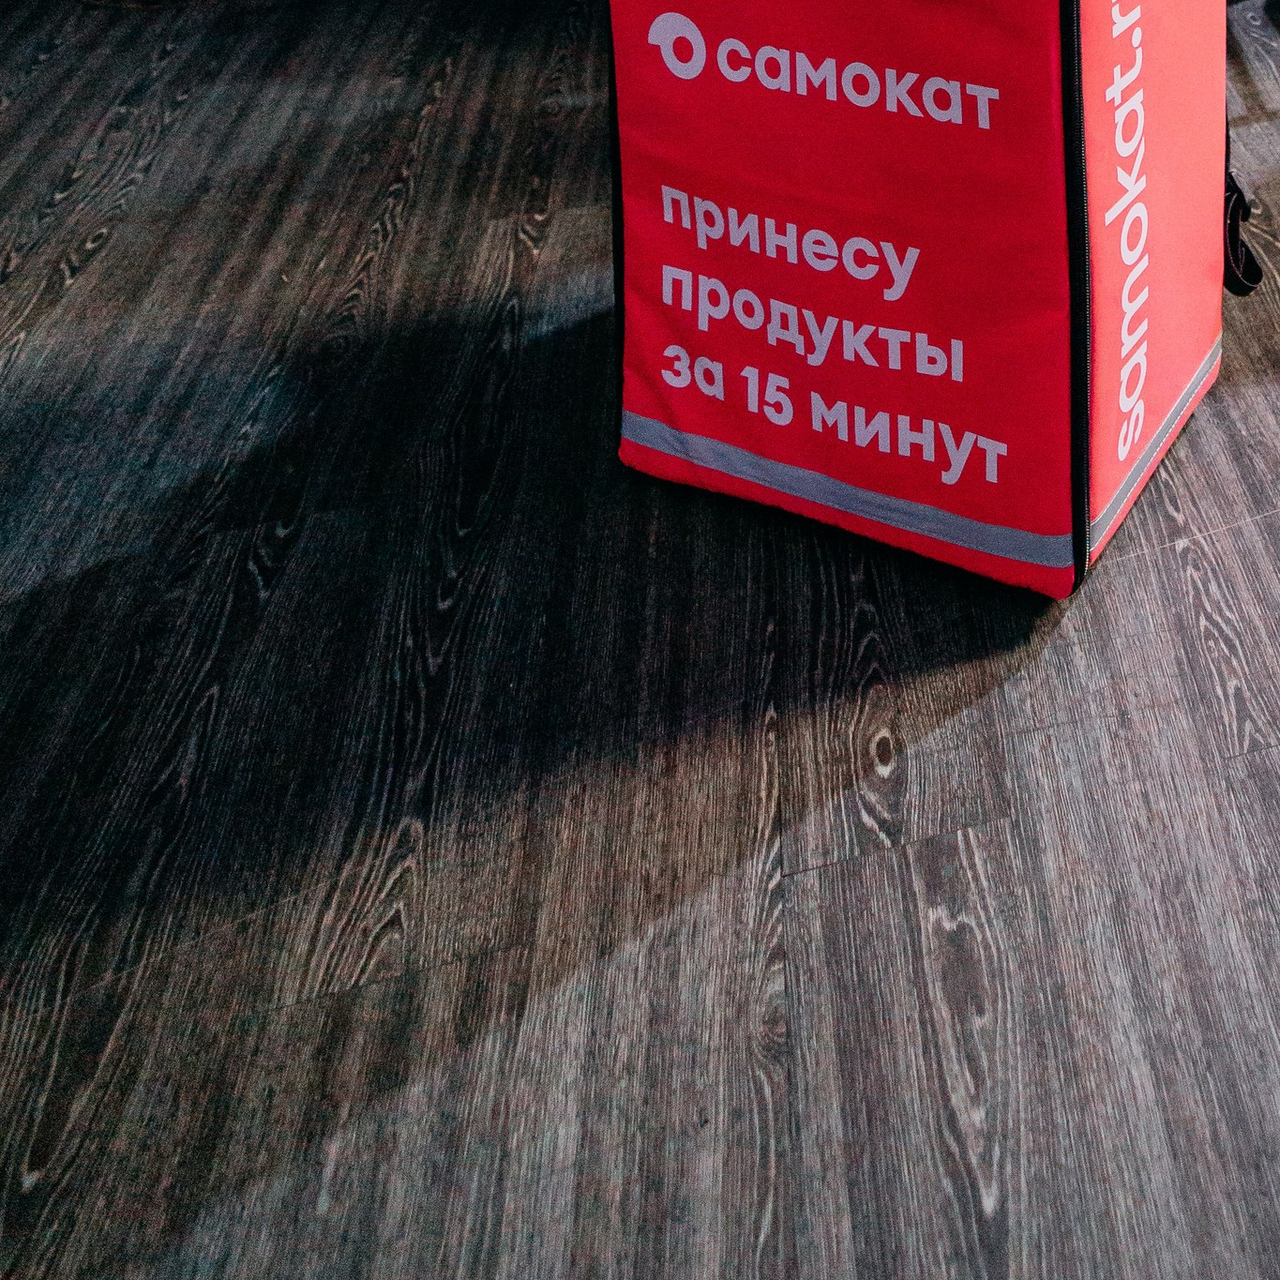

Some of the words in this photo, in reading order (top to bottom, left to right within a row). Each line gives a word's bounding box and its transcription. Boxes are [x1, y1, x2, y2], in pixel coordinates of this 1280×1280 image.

[716, 38, 1000, 131] самокат
[661, 184, 921, 301] принесу
[661, 266, 964, 383] продукты
[661, 344, 725, 400] за
[740, 366, 793, 427] 15
[810, 388, 1008, 486] минут
